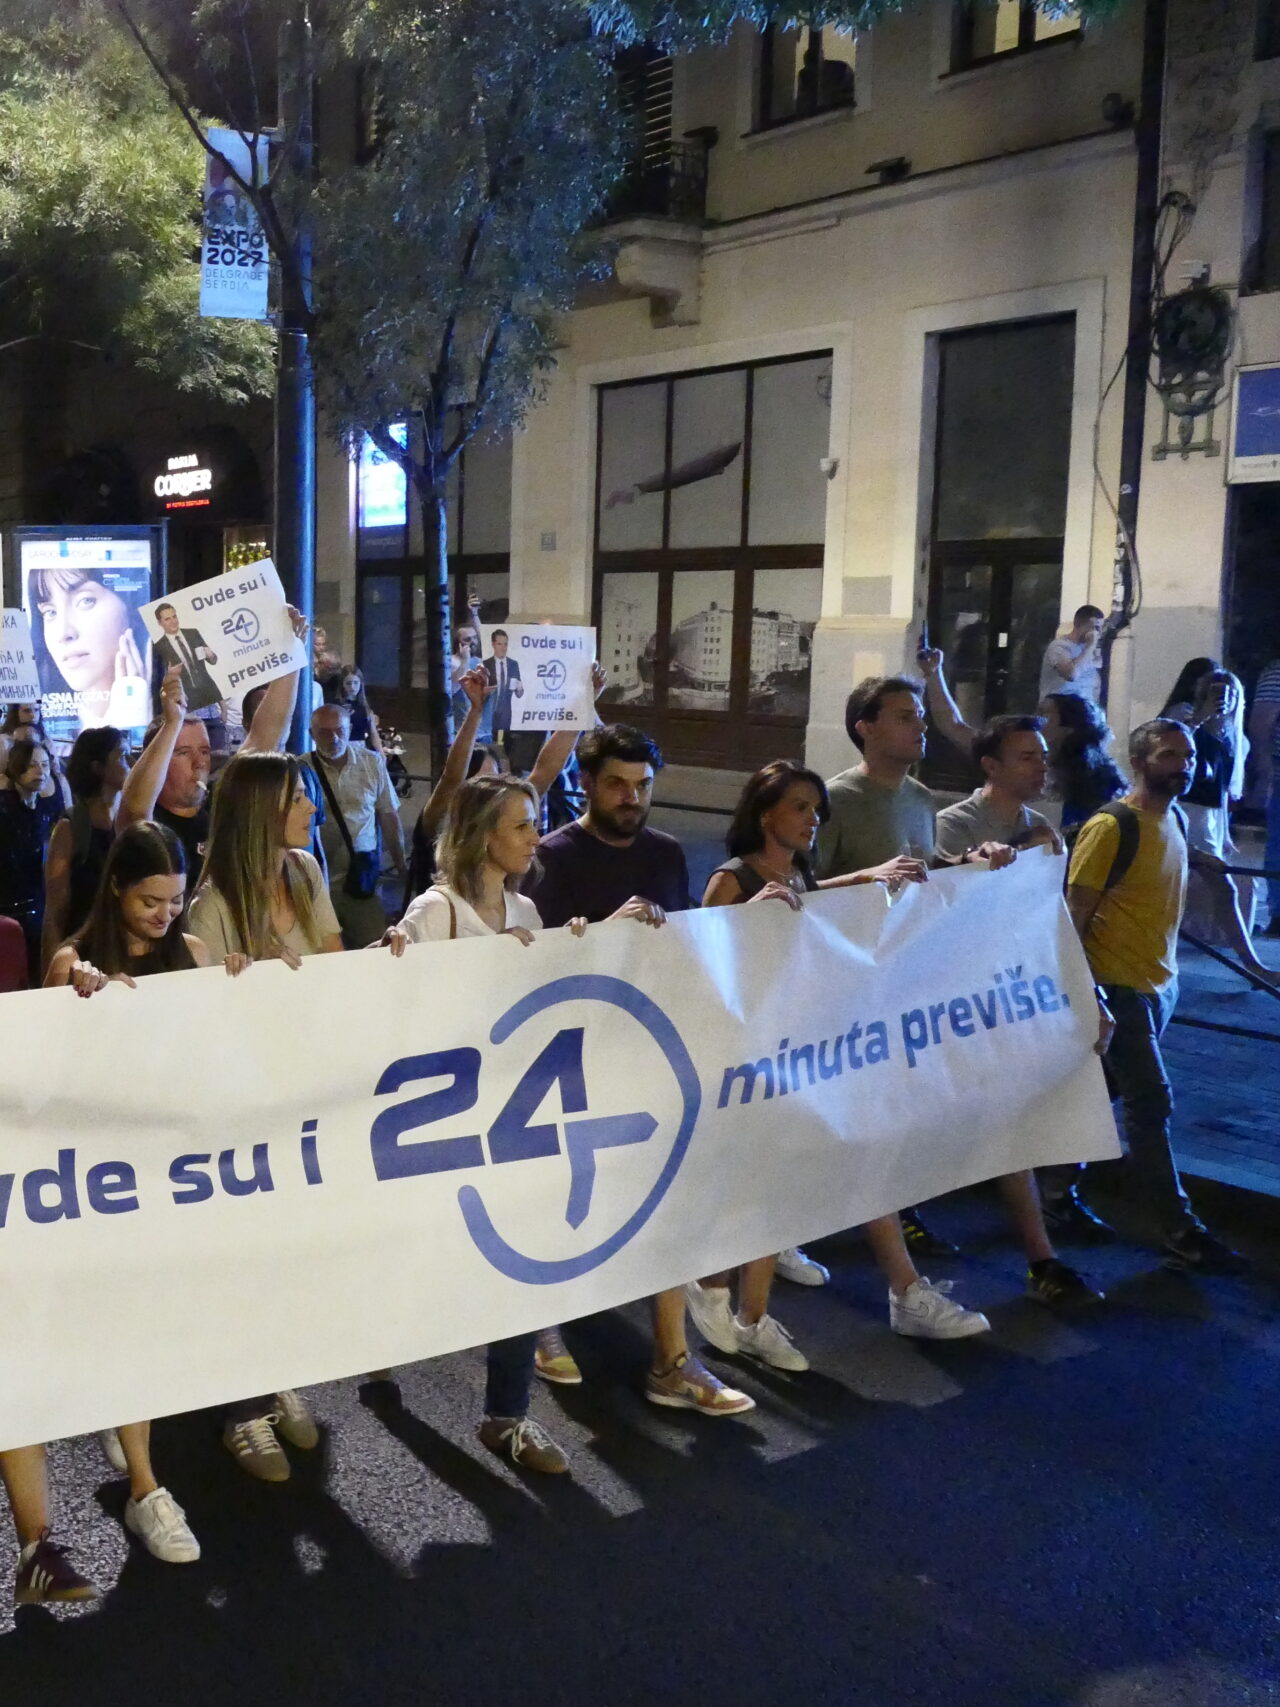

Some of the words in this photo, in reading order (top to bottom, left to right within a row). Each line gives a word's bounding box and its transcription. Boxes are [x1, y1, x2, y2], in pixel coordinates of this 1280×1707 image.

[207, 228, 264, 249] EXPO
[207, 248, 264, 267] 2027
[191, 588, 236, 611] Ovde
[238, 580, 258, 595] su
[260, 573, 267, 586] i
[220, 614, 254, 636] 24
[232, 638, 271, 658] minuta
[520, 636, 556, 649] Ovde
[560, 640, 576, 650] su
[580, 637, 583, 650] i
[228, 652, 293, 688] previše.
[536, 664, 562, 686] 24
[536, 692, 566, 700] minuta
[522, 708, 578, 724] previše.
[168, 1142, 274, 1205] su
[301, 1118, 324, 1186] i
[370, 1026, 659, 1231] 24
[718, 1020, 891, 1109] minuta
[900, 963, 1071, 1068] previše.
